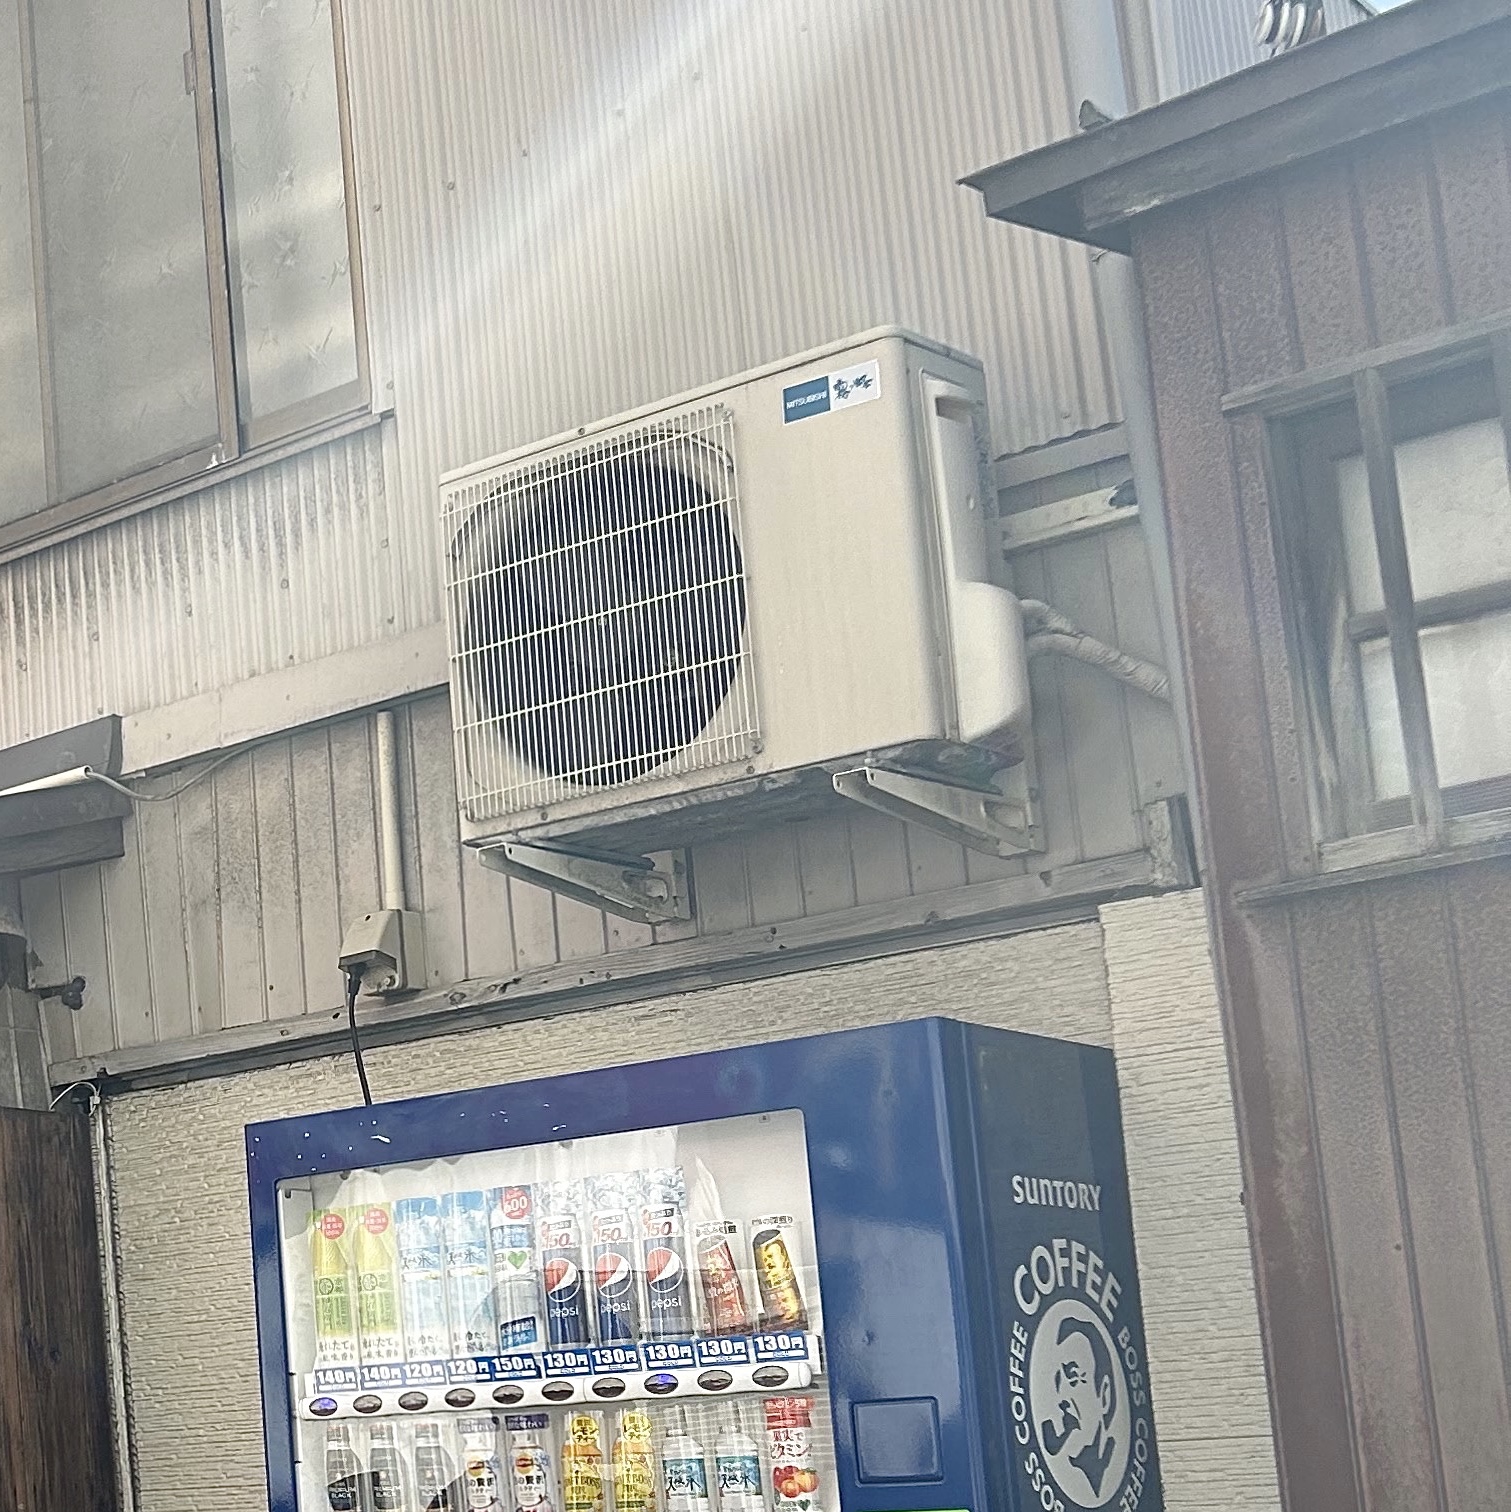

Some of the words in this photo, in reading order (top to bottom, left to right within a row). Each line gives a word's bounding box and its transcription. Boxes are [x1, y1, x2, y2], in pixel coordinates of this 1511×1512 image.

[1013, 1238, 1122, 1323] COFFEE
[698, 1340, 745, 1357] 130円
[754, 1334, 804, 1351] 130円
[592, 1348, 637, 1364] 130円
[647, 1343, 692, 1360] 130円
[448, 1359, 489, 1375] 120円
[493, 1356, 535, 1371] 150円
[544, 1352, 589, 1368] 130円
[1117, 1326, 1144, 1406] BOSS
[317, 1369, 355, 1384] 140円
[361, 1366, 402, 1381] 140円
[405, 1363, 443, 1378] 120円
[1011, 1320, 1029, 1445] COFFEE
